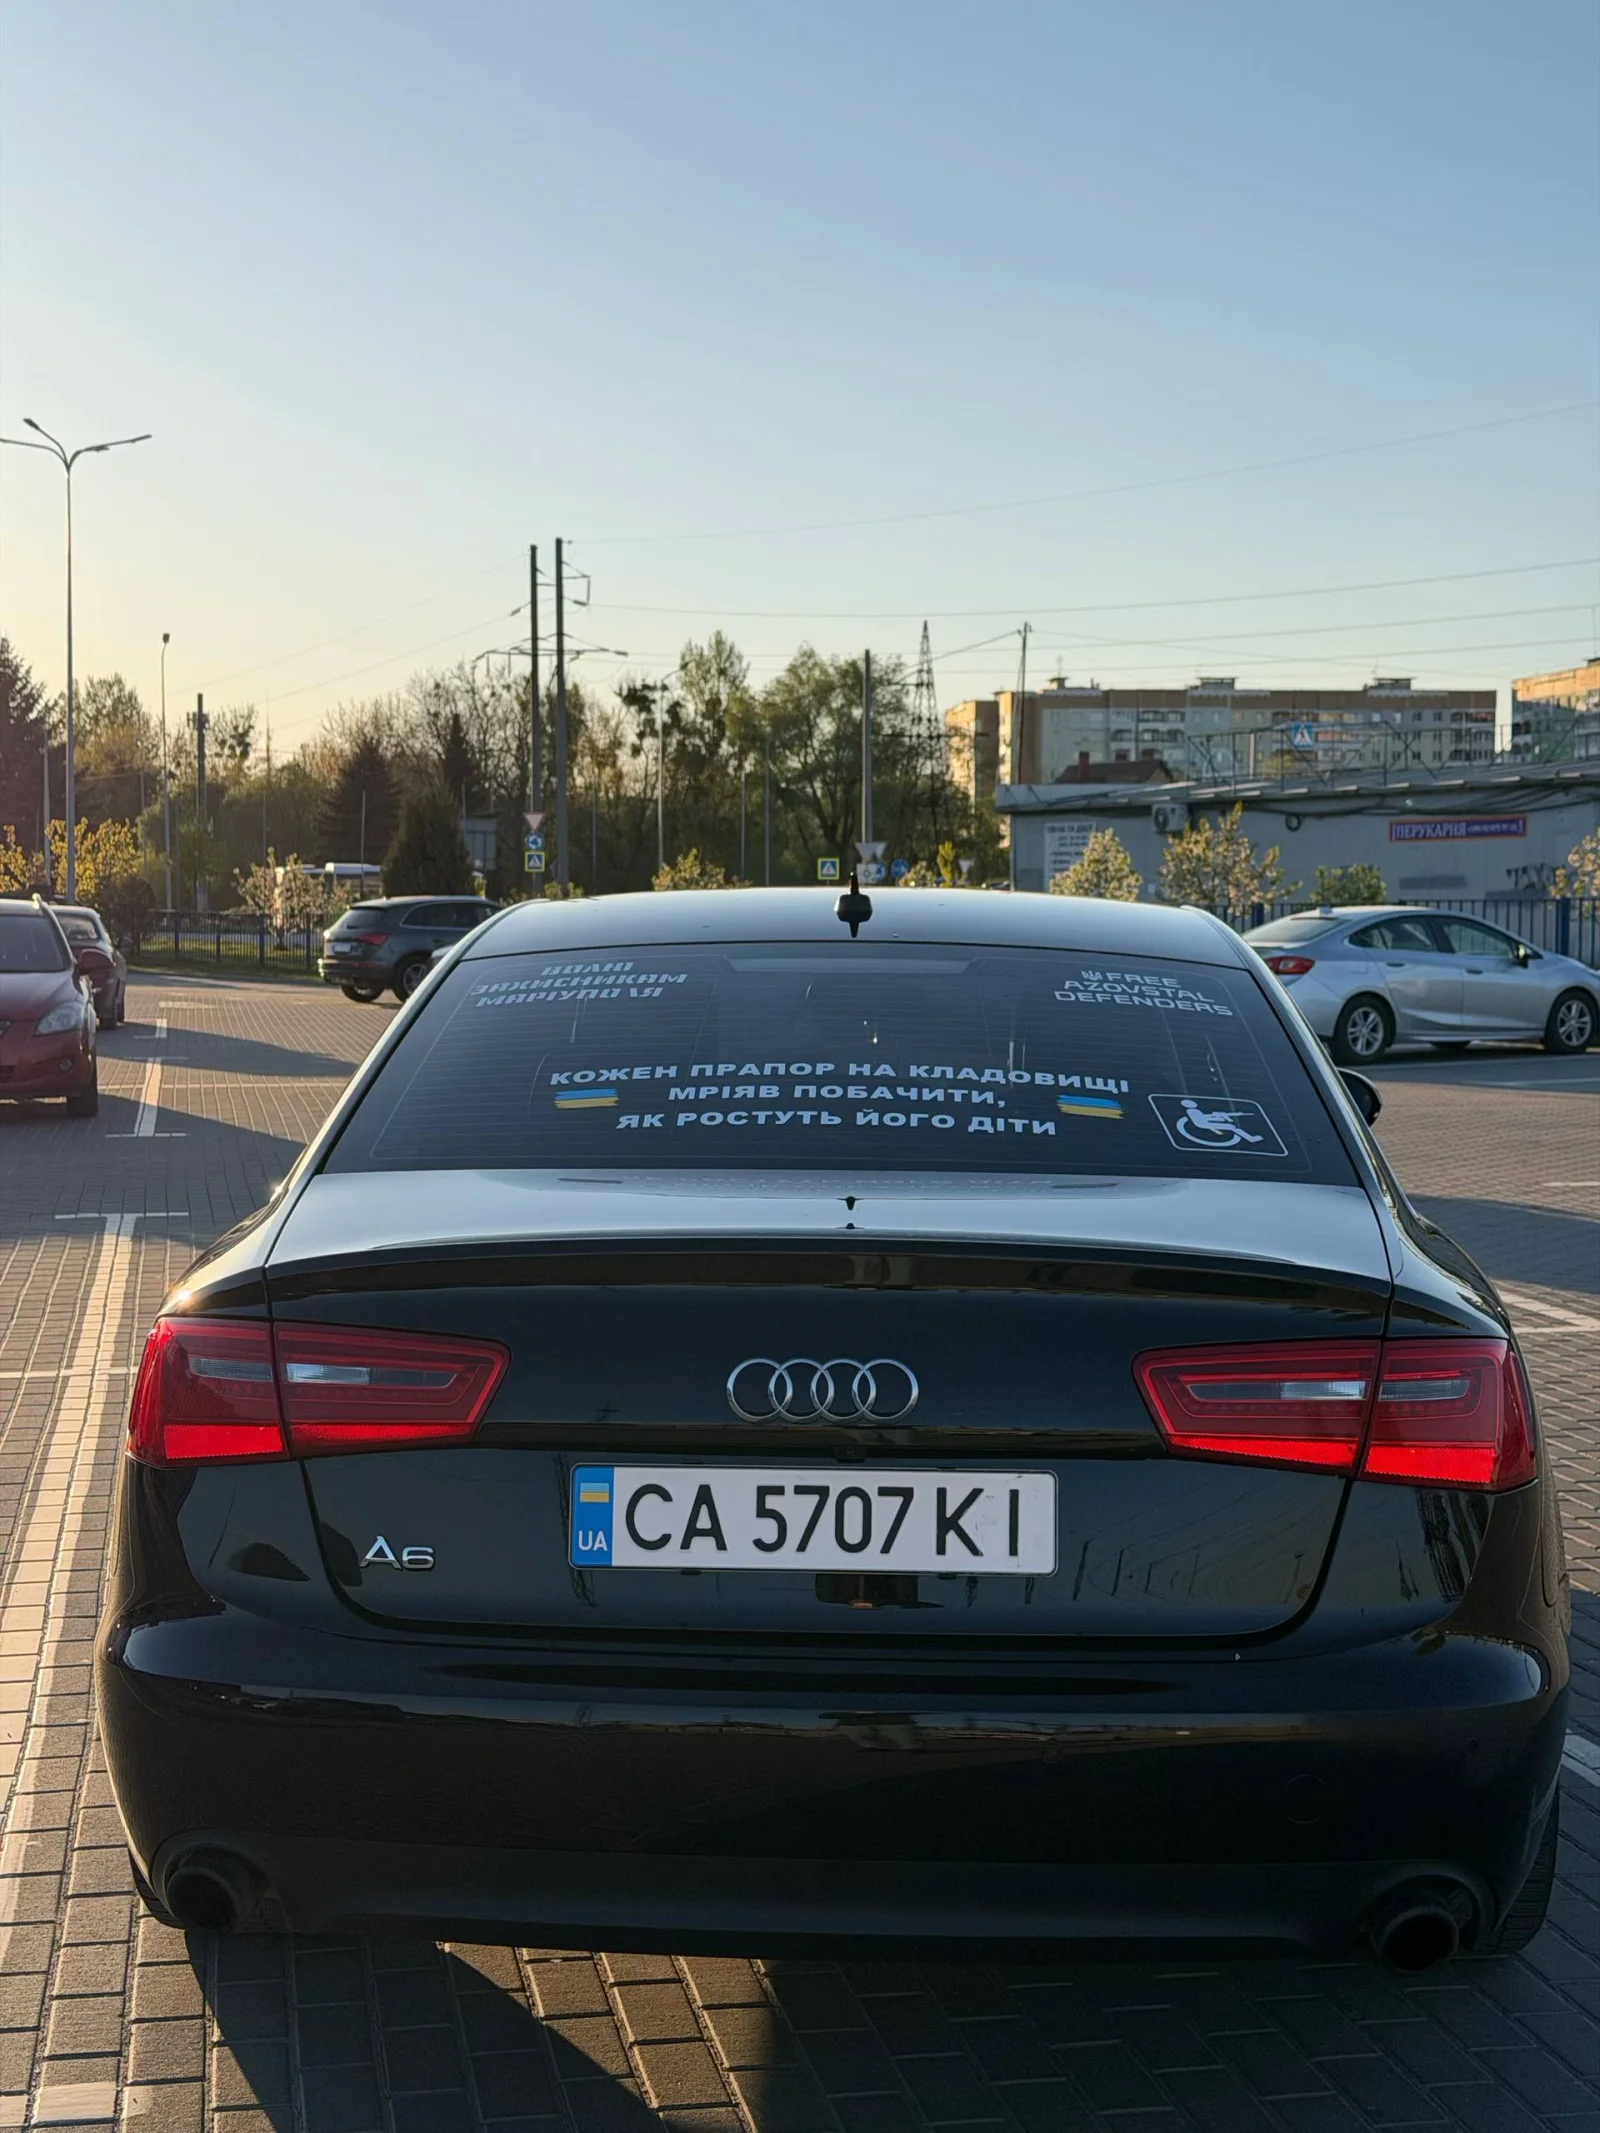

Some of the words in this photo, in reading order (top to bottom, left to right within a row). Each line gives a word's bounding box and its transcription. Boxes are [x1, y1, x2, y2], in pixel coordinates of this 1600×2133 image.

[471, 973, 688, 996] ЗАХИСНИКАМ
[1064, 980, 1215, 1003] AZOVSTAL
[1106, 972, 1181, 988] FREE
[1054, 991, 1234, 1016] DEFENDERS
[550, 1065, 678, 1086] КОЖЕН
[690, 1063, 836, 1077] ПРАПОР
[848, 1063, 897, 1077] НА
[909, 1064, 1130, 1094] КЛАДОВИЩІ
[668, 1085, 781, 1101] МРІЯВ
[793, 1085, 1005, 1108] ПОБАЧИТИ,
[615, 1112, 665, 1129] ЯК
[676, 1110, 842, 1127] РОСТУТЬ
[855, 1108, 955, 1128] ЙОГО
[967, 1116, 1056, 1135] ДІТИ
[625, 1483, 727, 1552] CA
[751, 1485, 916, 1555] 5707
[359, 1535, 434, 1569] A6
[578, 1530, 608, 1551] UA
